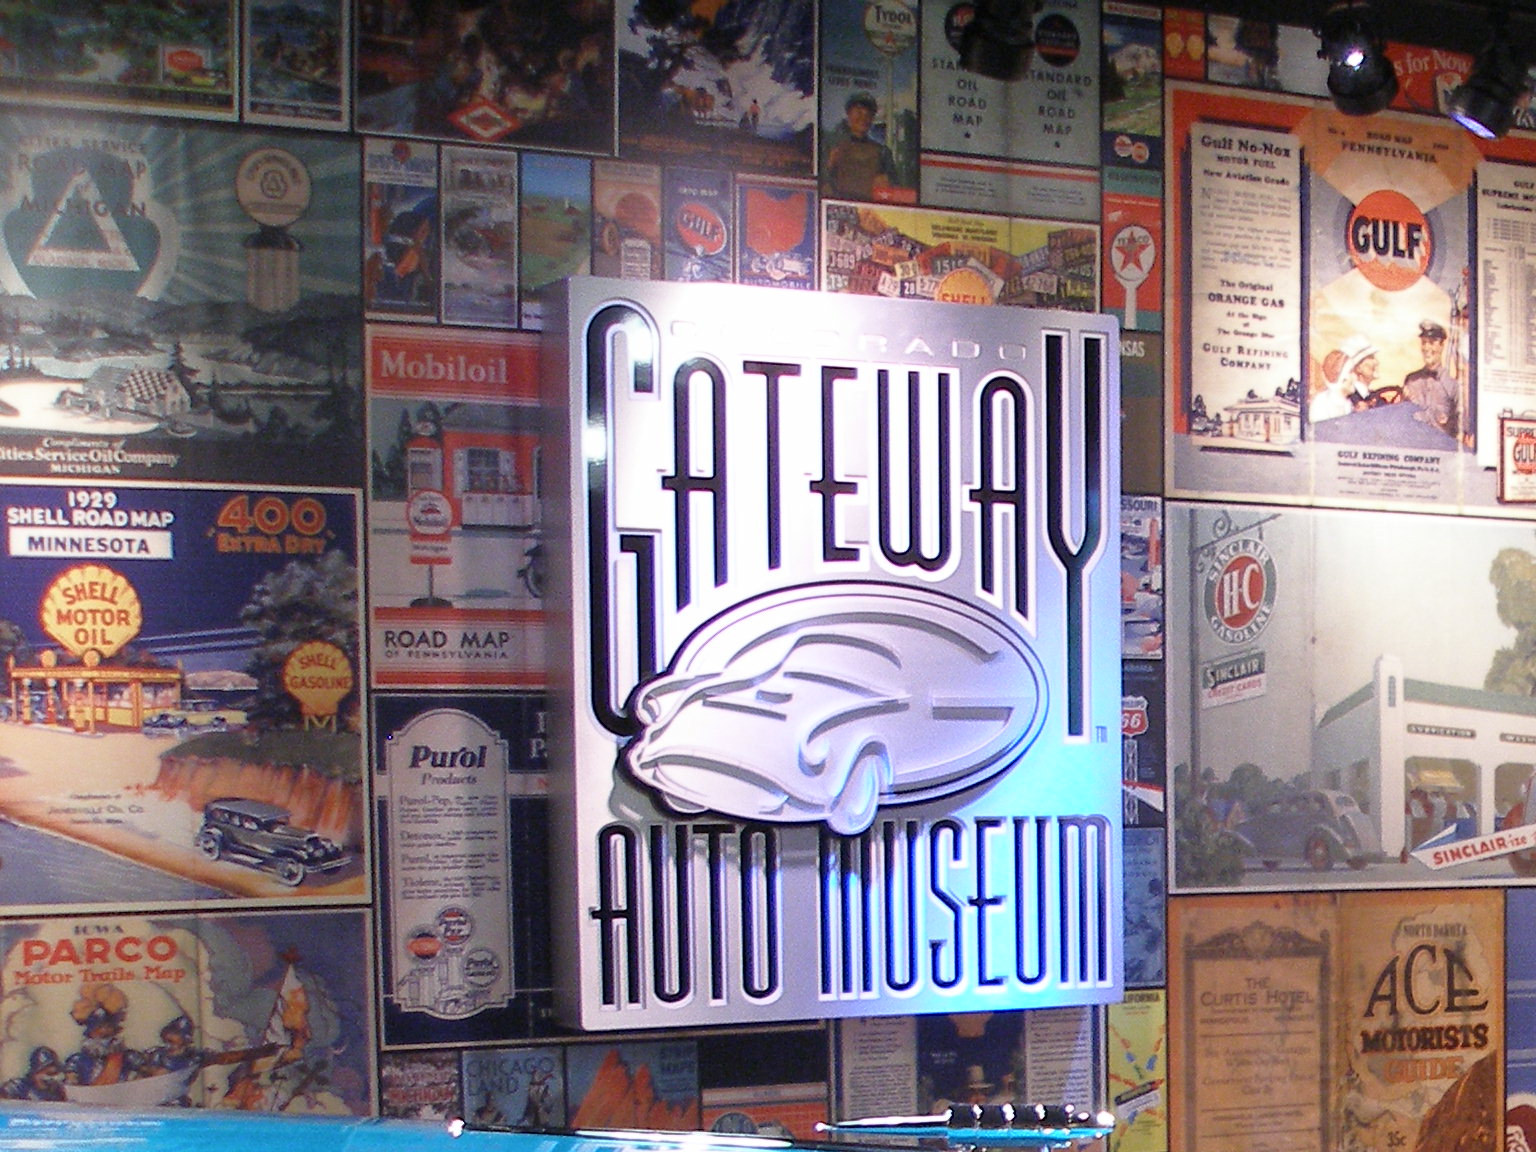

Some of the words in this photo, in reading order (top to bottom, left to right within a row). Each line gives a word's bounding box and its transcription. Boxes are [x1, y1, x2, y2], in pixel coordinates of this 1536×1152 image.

[957, 78, 978, 91] OIL
[949, 96, 987, 110] ROAD
[1038, 105, 1075, 119] ROAD
[953, 113, 983, 127] MAP
[1043, 122, 1072, 136] MAP
[1201, 135, 1233, 151] Gulf
[1341, 140, 1437, 163] PENNSYLVANIA
[1253, 158, 1276, 169] FUEL
[1351, 215, 1423, 262] GULF
[1261, 297, 1285, 308] GAS
[1203, 343, 1232, 354] GULF
[380, 350, 508, 385] Mobiloil
[0, 446, 34, 462] ities
[35, 446, 88, 462] Service
[89, 446, 113, 462] Oil
[113, 449, 180, 467] Company
[51, 463, 122, 475] MICHIGAN
[68, 491, 117, 508] 1929
[1121, 501, 1158, 514] SSOURI
[7, 508, 69, 525] SHELL
[72, 508, 128, 527] ROAD
[131, 510, 175, 528] MAP
[217, 494, 327, 536] 400
[586, 300, 1104, 740] GATEWAY
[28, 535, 150, 554] MINNESOTA
[1208, 540, 1270, 582] SINCLAIR
[61, 581, 118, 604] SHELL
[56, 609, 131, 626] MOTOR
[1210, 602, 1272, 643] GASOLINE
[74, 628, 113, 646] OIL
[385, 630, 448, 649] ROAD
[460, 630, 511, 649] MAP
[299, 653, 338, 670] SHELL
[408, 651, 509, 660] PENNSYLVANIA
[290, 676, 352, 690] GASOLINE
[1206, 659, 1261, 689] SINCLAIR
[1121, 712, 1142, 728] 66
[409, 744, 488, 769] Purol
[421, 772, 478, 785] Products
[591, 822, 779, 1005] AUTO
[820, 814, 1110, 996] MUSEUM
[21, 935, 179, 967] PARCO
[14, 970, 73, 985] Motor
[78, 967, 136, 984] Trails
[143, 965, 187, 984] Map
[1245, 977, 1271, 990] THE
[1363, 943, 1489, 1019] ACE
[1200, 991, 1257, 1007] CURTIS
[1266, 989, 1315, 1004] HOTEL
[1360, 1023, 1489, 1054] MOTORISTS
[465, 1056, 556, 1077] CHICAGO
[1382, 1055, 1465, 1084] GUIDE
[467, 1076, 521, 1096] LAND
